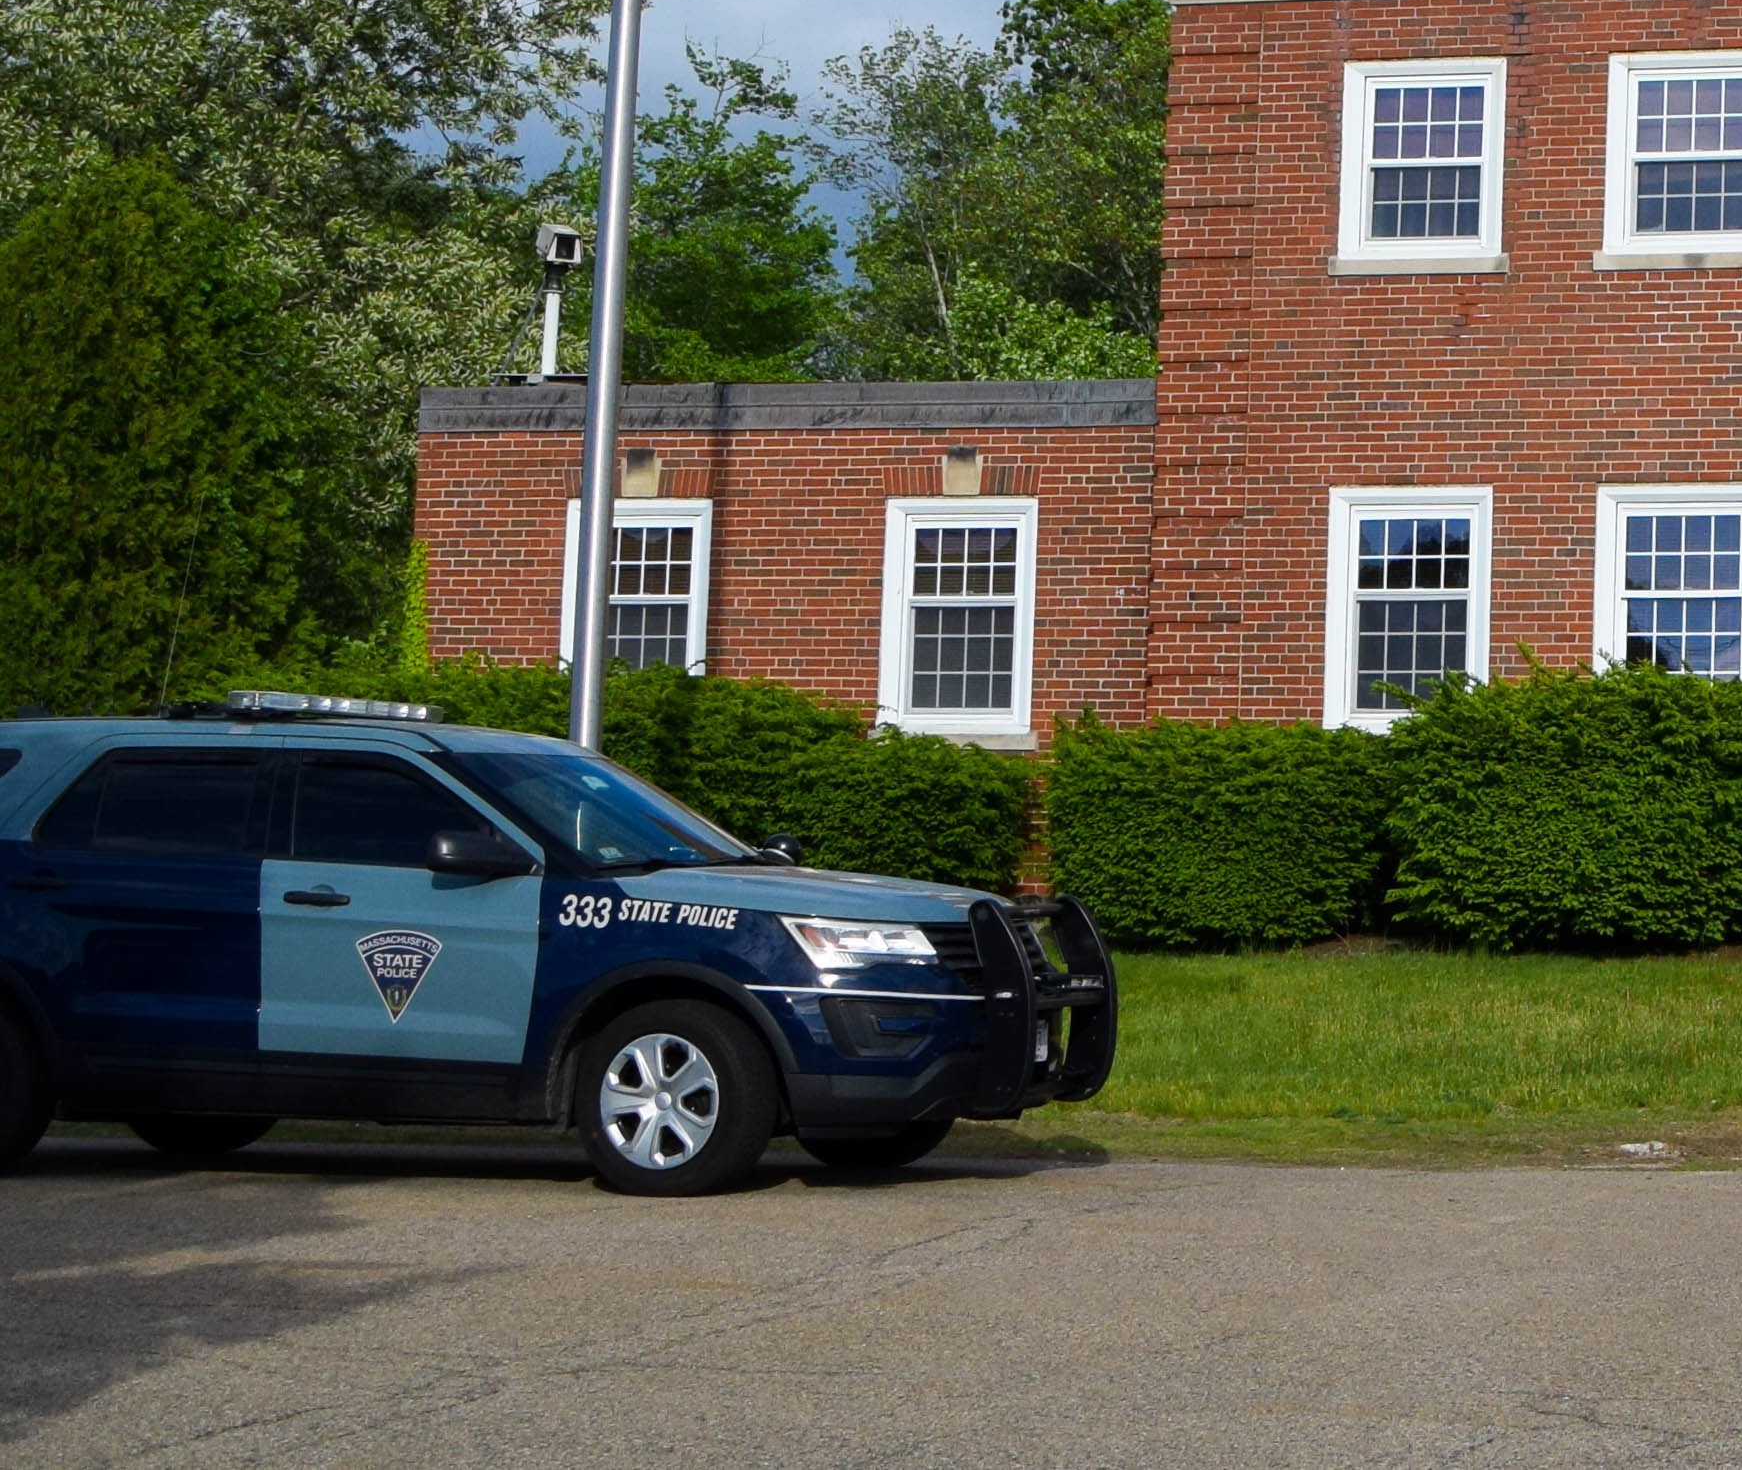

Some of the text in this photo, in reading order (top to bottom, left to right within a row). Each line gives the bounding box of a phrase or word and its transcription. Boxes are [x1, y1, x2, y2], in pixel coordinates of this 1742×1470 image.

[559, 894, 739, 930] 333 STATE POLICE
[360, 935, 438, 953] MASSACHUSETTS
[373, 953, 424, 968] STATE
[376, 968, 417, 978] POLICE
